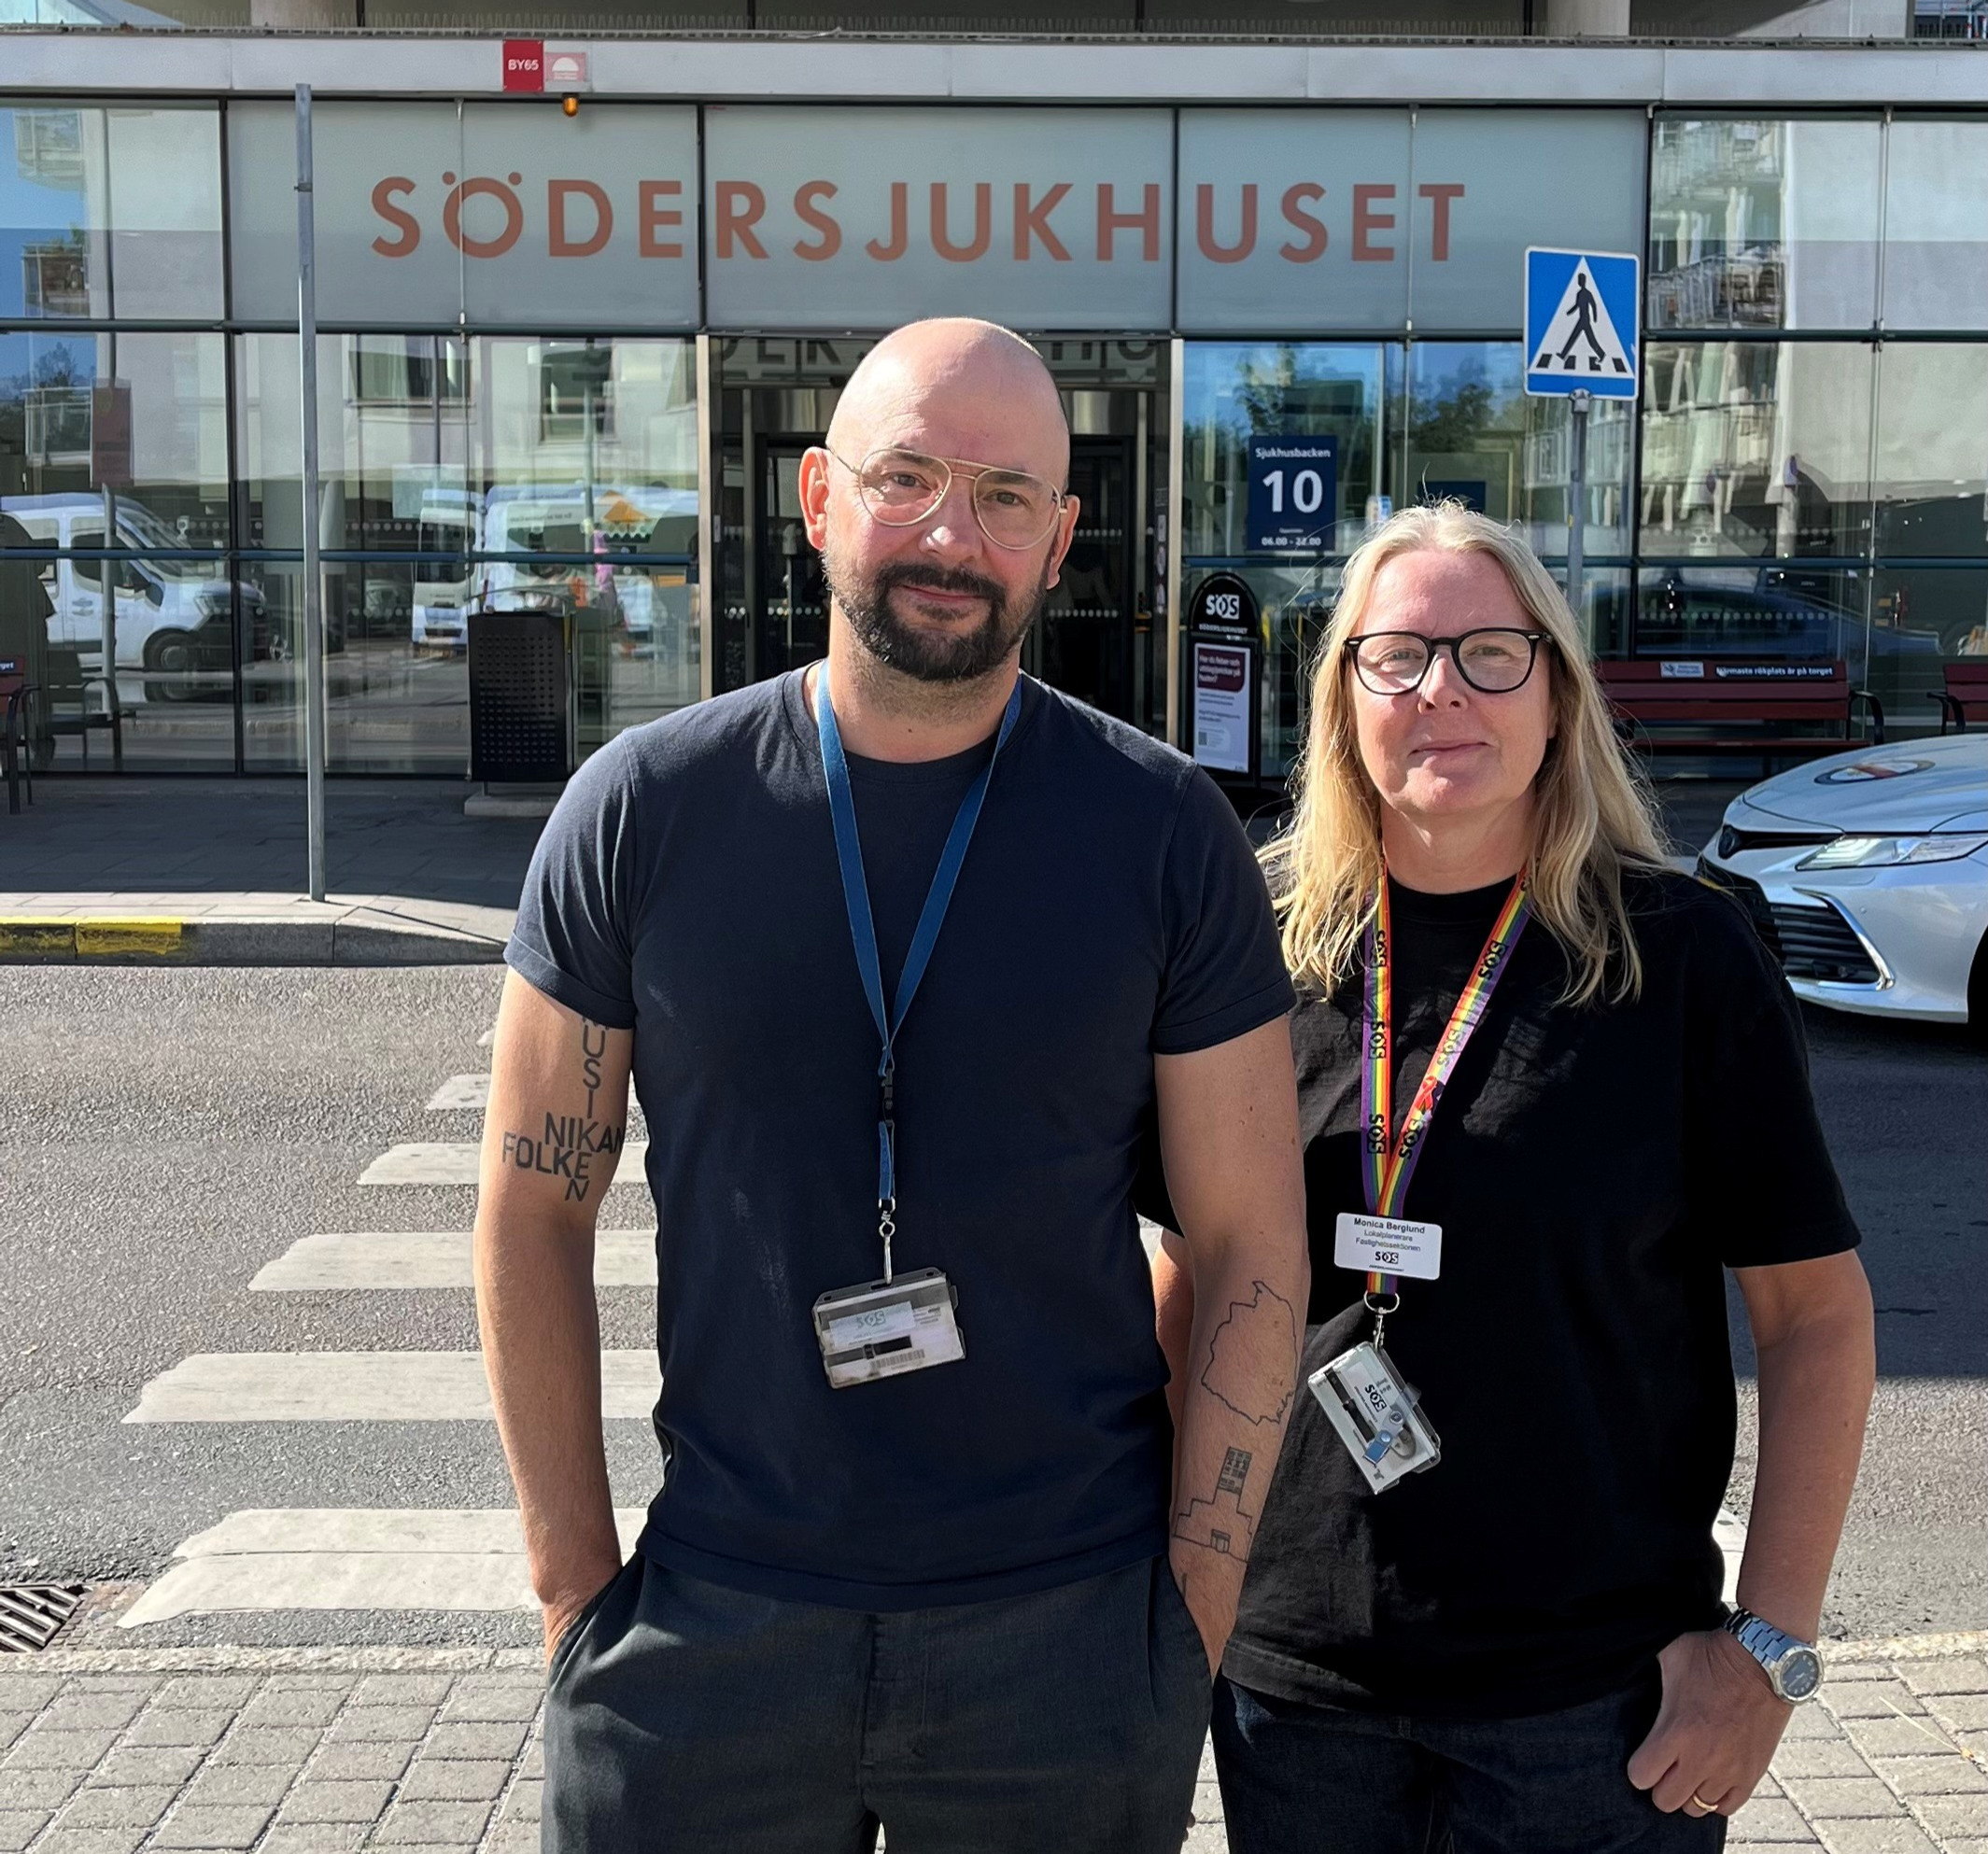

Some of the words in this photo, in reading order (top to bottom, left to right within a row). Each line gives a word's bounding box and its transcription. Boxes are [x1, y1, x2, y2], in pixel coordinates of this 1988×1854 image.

[371, 170, 1465, 263] SÖDERSJUKHUSET
[1255, 447, 1331, 459] Sjukhusbacken
[1262, 470, 1323, 513] 10
[1809, 667, 1833, 676] torget
[1354, 1217, 1384, 1229] Monica
[1387, 1221, 1425, 1234] Berglund
[1364, 1229, 1413, 1242] Lokalplanerare
[1356, 1237, 1421, 1252] Fastighetssektionen
